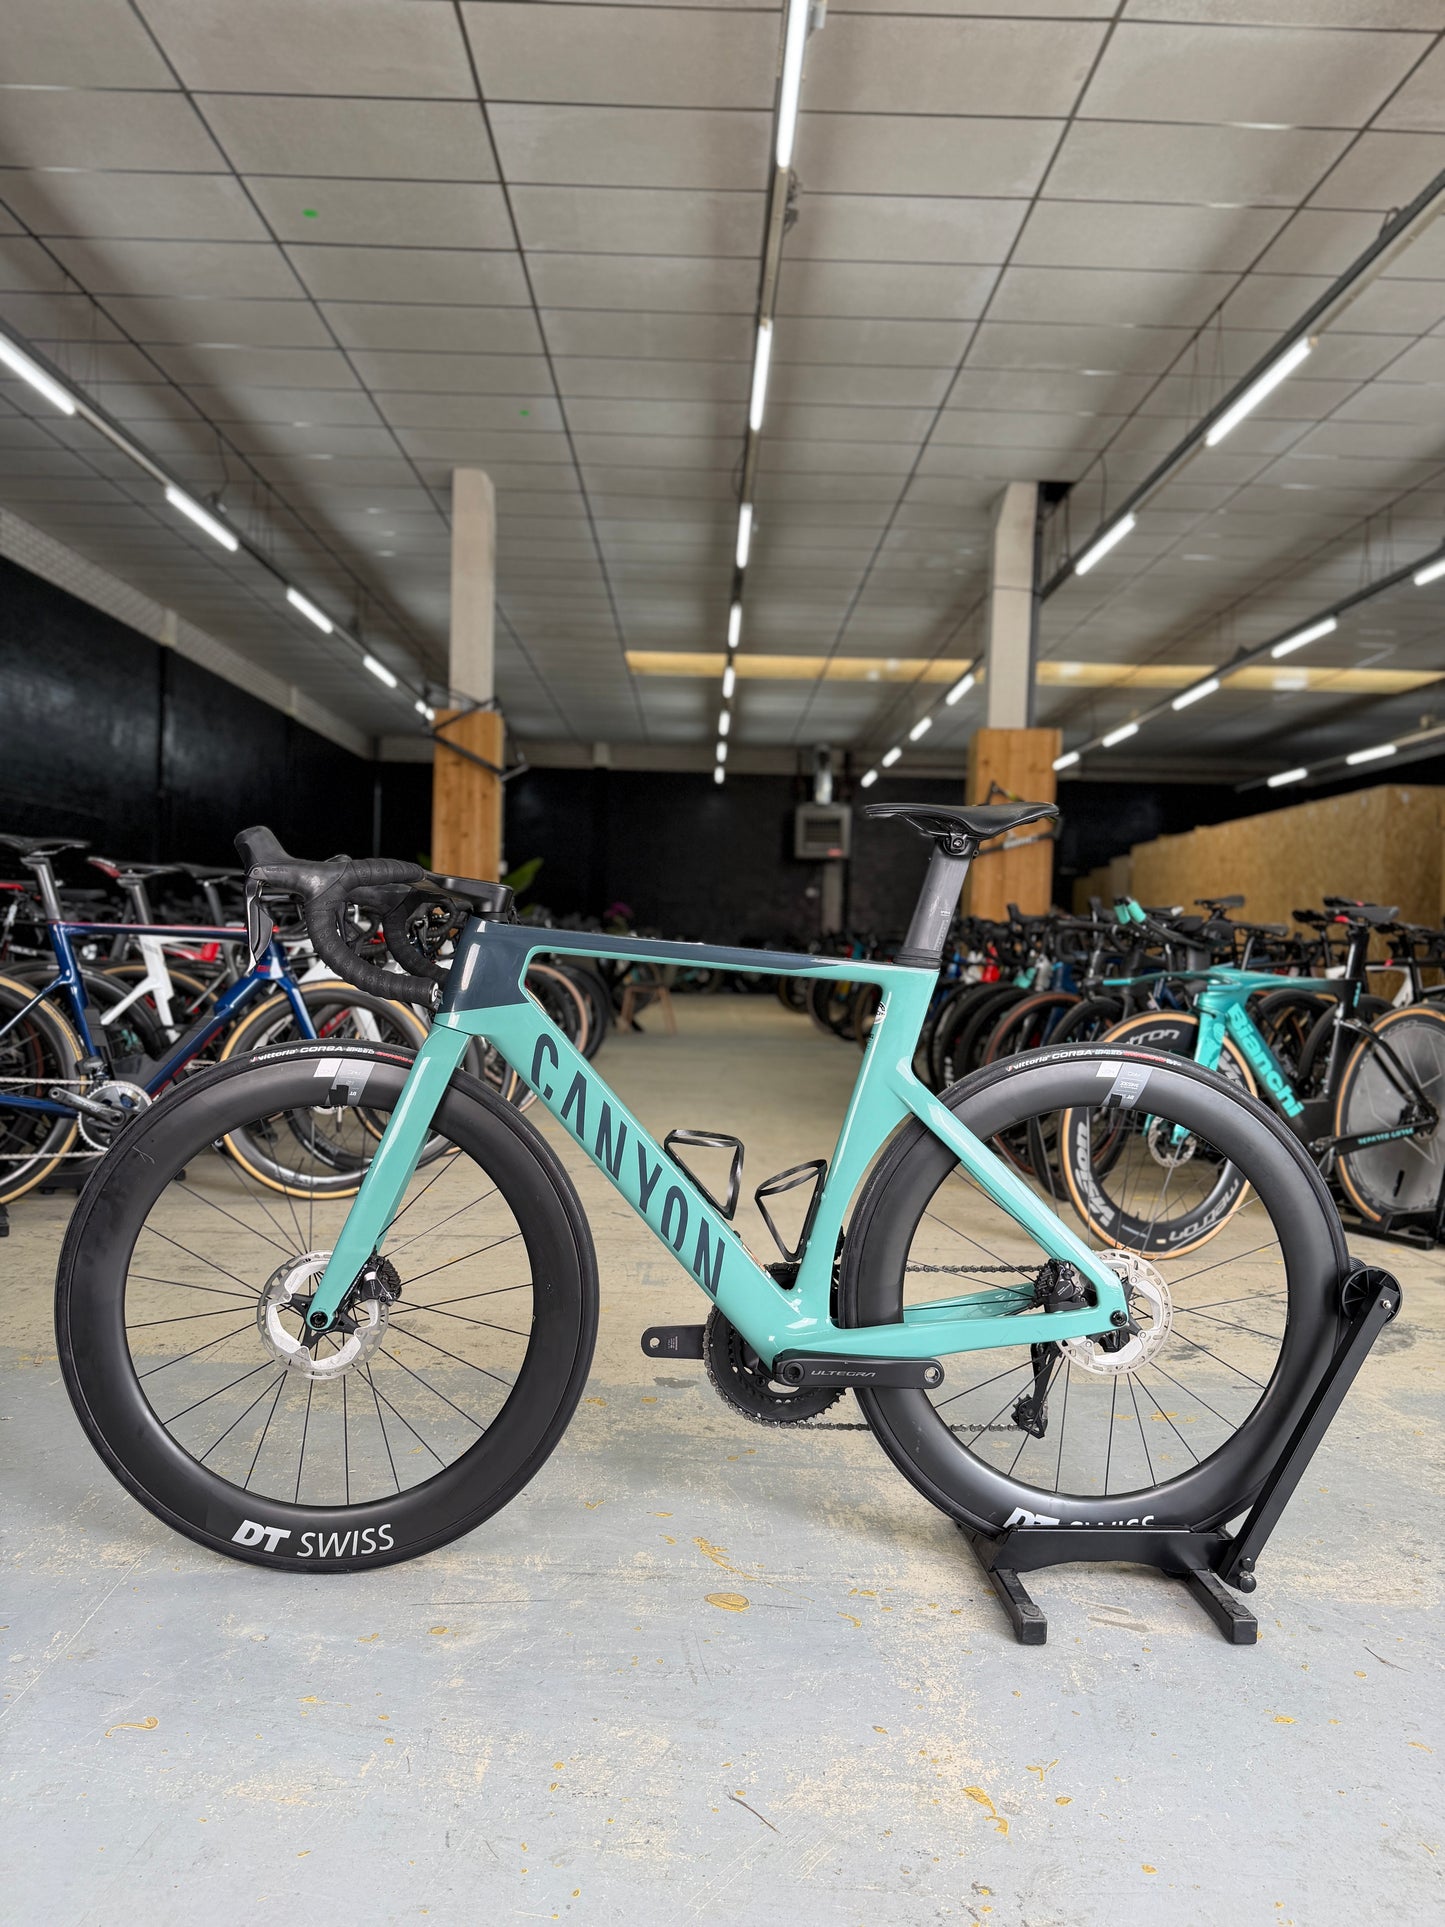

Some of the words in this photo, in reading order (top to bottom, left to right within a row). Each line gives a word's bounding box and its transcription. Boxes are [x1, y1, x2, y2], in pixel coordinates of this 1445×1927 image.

[256, 1049, 296, 1062] vittoria
[300, 1045, 344, 1053] CORSA
[1012, 1054, 1050, 1069] vittoria
[1052, 1049, 1092, 1060] CORSA
[1227, 1002, 1305, 1118] Bianchi
[531, 1033, 726, 1298] CANYON
[1168, 1177, 1240, 1242] metron
[811, 1369, 876, 1378] ULTEGRA
[231, 1519, 292, 1553] DT
[296, 1523, 395, 1558] SWISS
